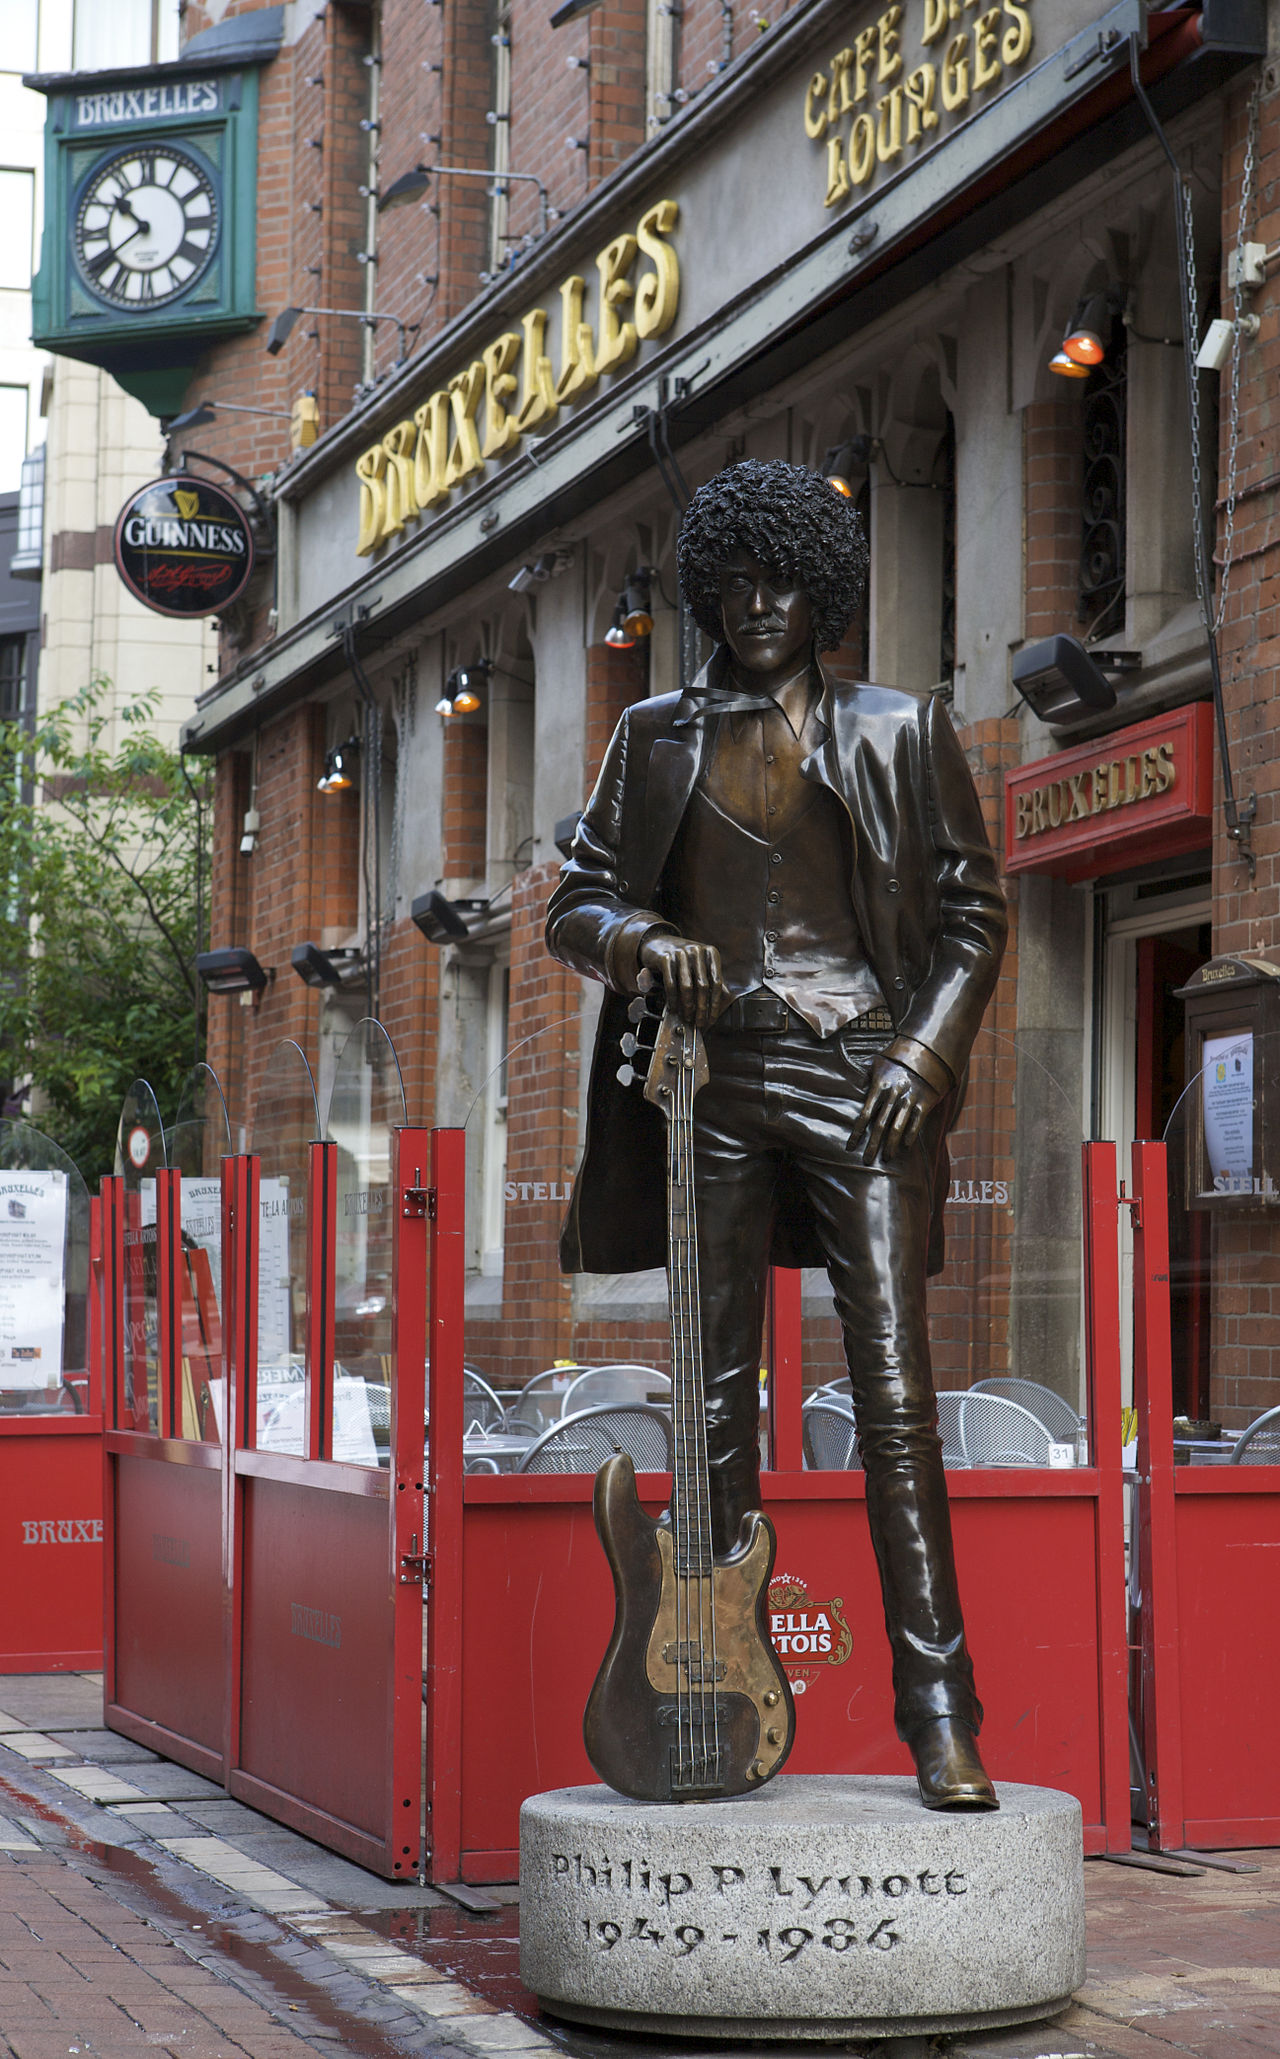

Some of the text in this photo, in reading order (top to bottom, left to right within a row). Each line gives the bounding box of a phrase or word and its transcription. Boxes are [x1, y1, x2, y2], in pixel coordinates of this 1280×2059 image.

[76, 80, 218, 126] BRUXELLES
[823, 0, 1032, 208] LOUNGES
[356, 199, 679, 557] BRUXELLES
[125, 517, 244, 554] GUINNESS
[1014, 742, 1176, 841] BRUXELLES
[1202, 964, 1236, 982] Bruxelles
[945, 1180, 1009, 1204] LLES
[1053, 1448, 1069, 1460] 31
[785, 1668, 811, 1678] VEN
[551, 1853, 968, 1910] Philip P Lynott
[582, 1916, 706, 1958] 1949
[757, 1917, 899, 1964] 1986
